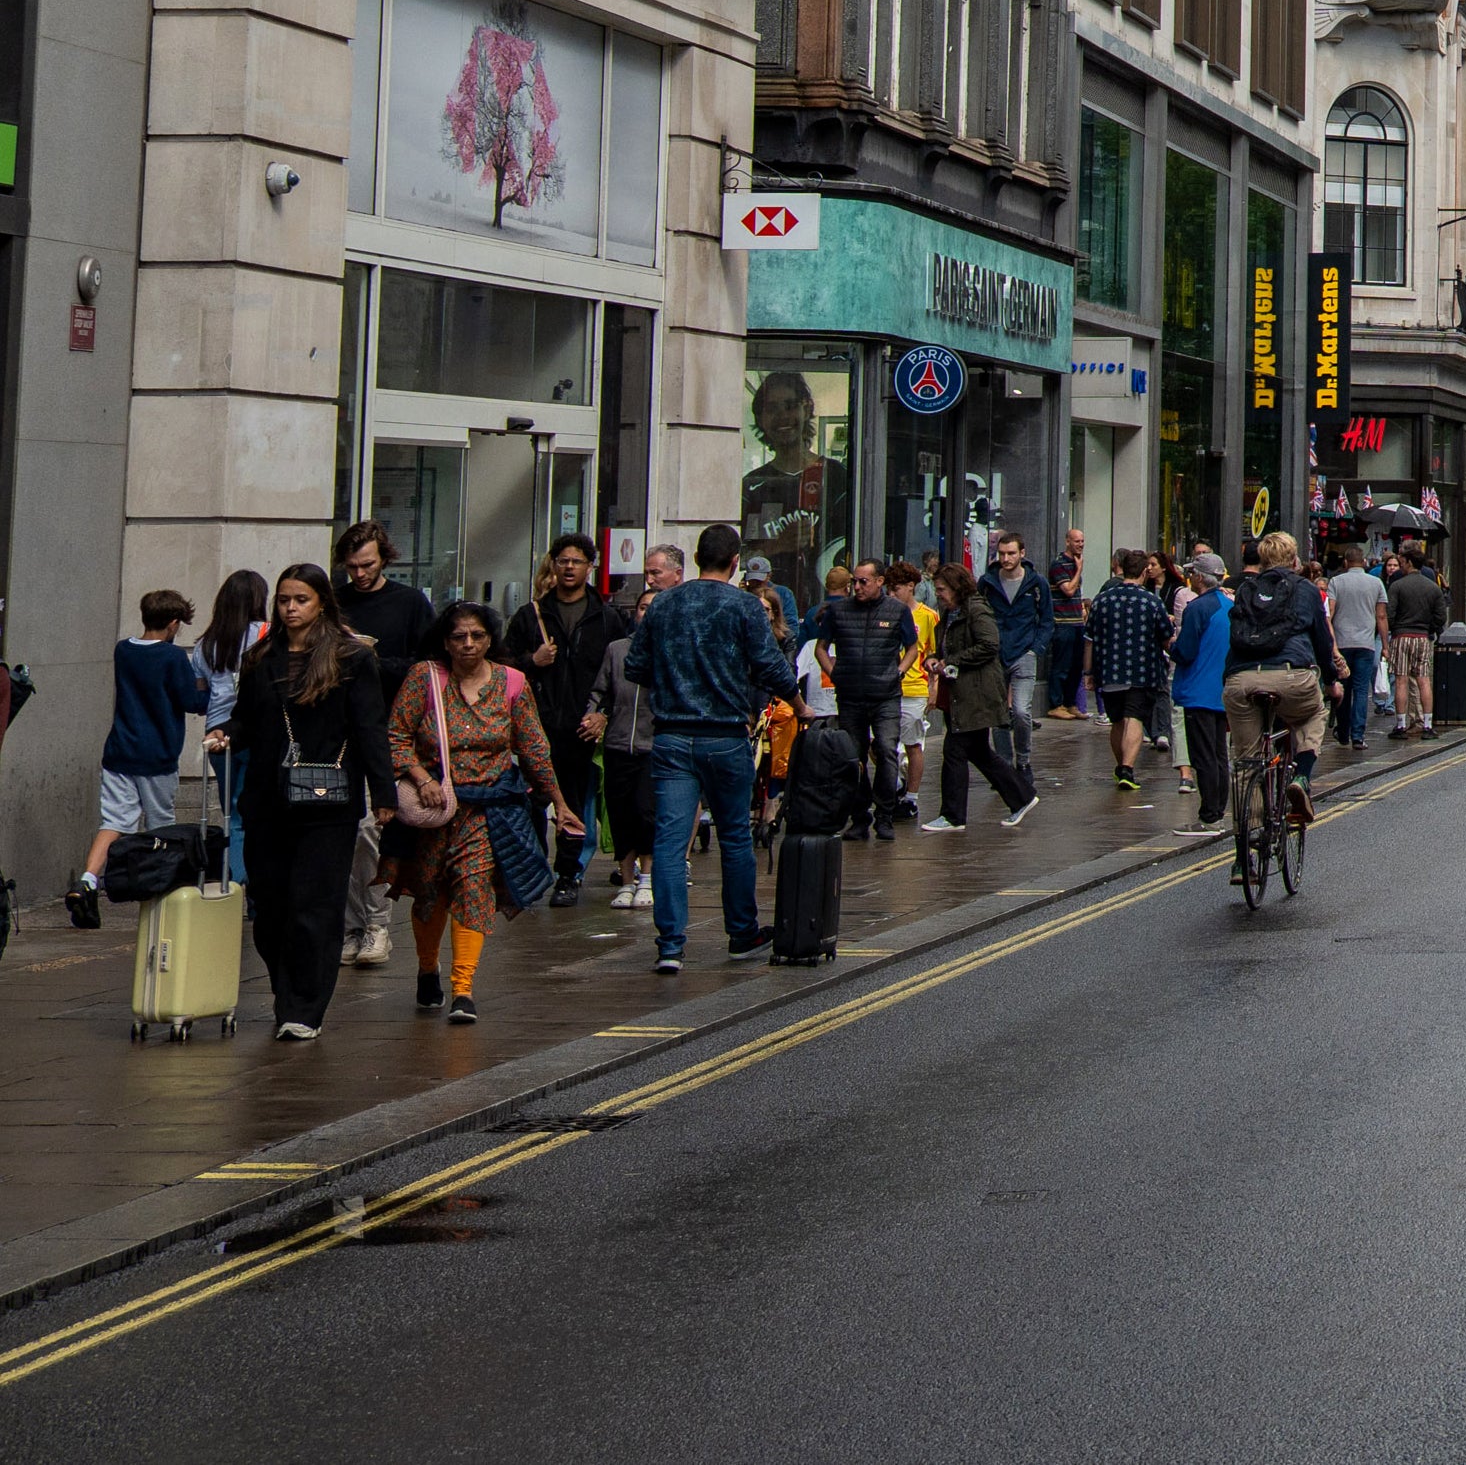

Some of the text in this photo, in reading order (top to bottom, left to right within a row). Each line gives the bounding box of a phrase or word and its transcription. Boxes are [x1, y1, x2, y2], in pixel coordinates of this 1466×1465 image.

[933, 252, 971, 320] PARIS
[908, 349, 952, 366] PARIS
[1340, 416, 1387, 453] H&M
